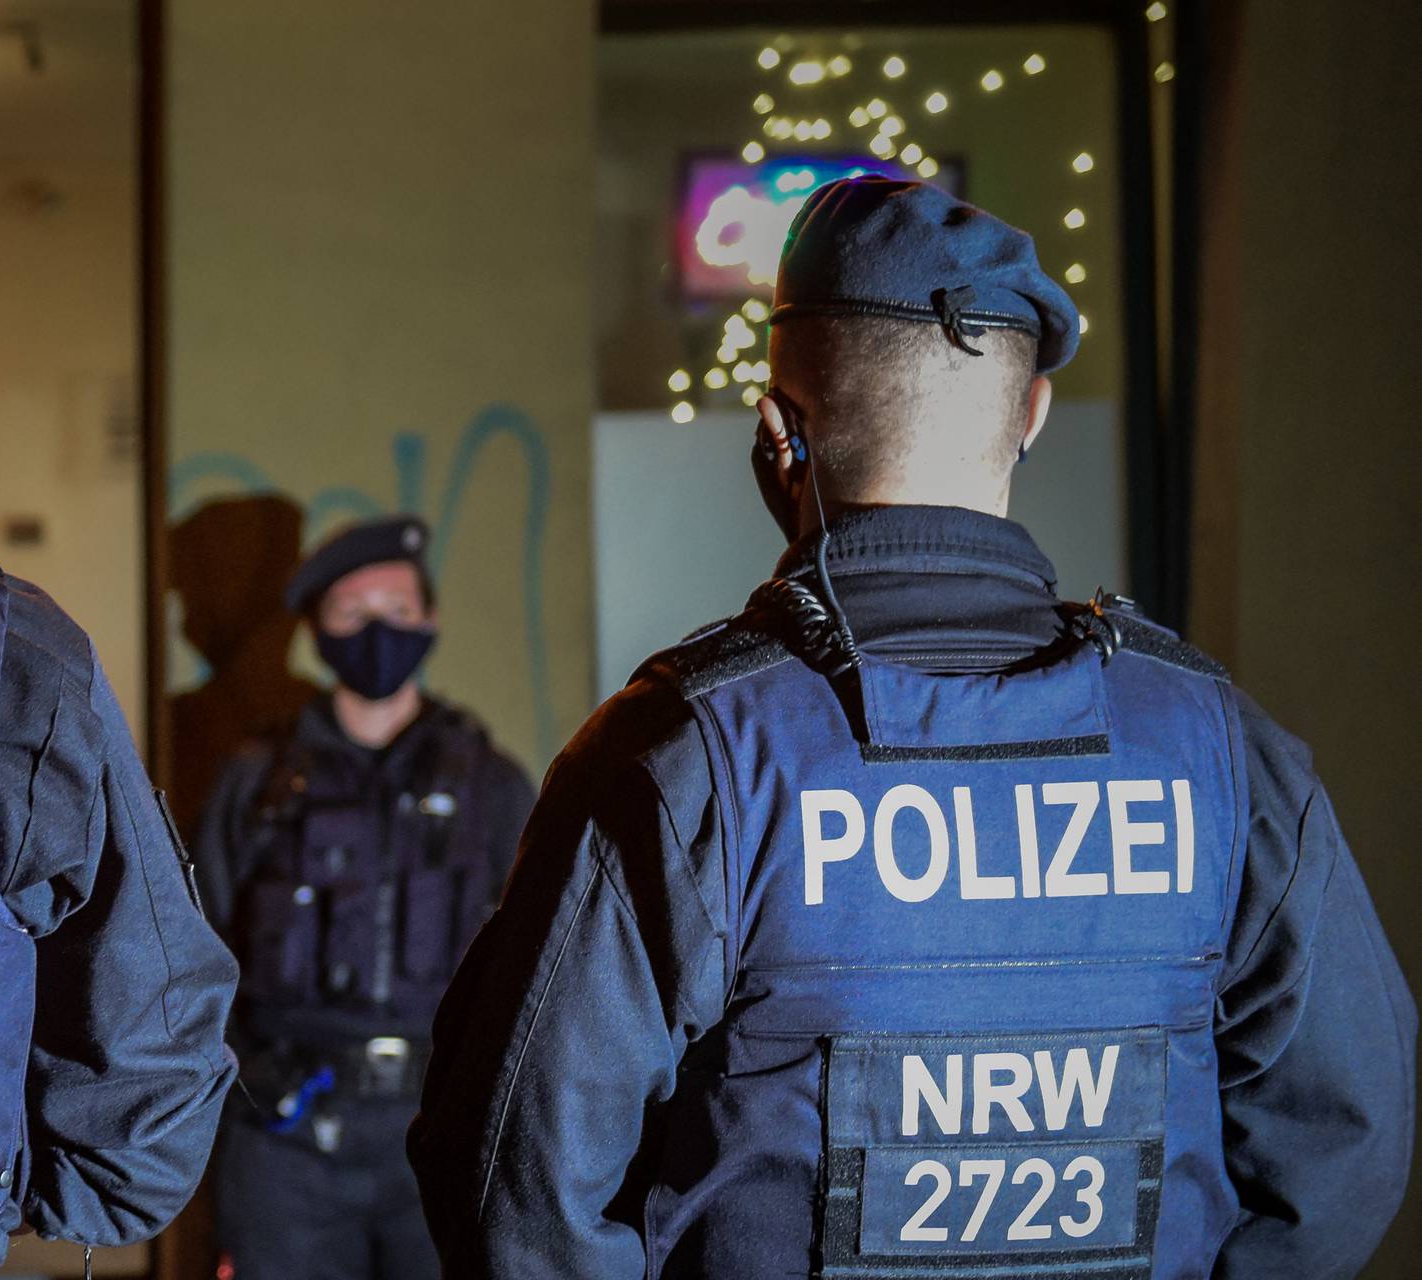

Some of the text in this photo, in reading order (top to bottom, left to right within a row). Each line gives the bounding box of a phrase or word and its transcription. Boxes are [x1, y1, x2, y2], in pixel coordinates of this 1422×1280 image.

[800, 779, 1194, 905] POLIZEI
[901, 1045, 1120, 1136] NRW
[900, 1156, 1105, 1241] 2723
